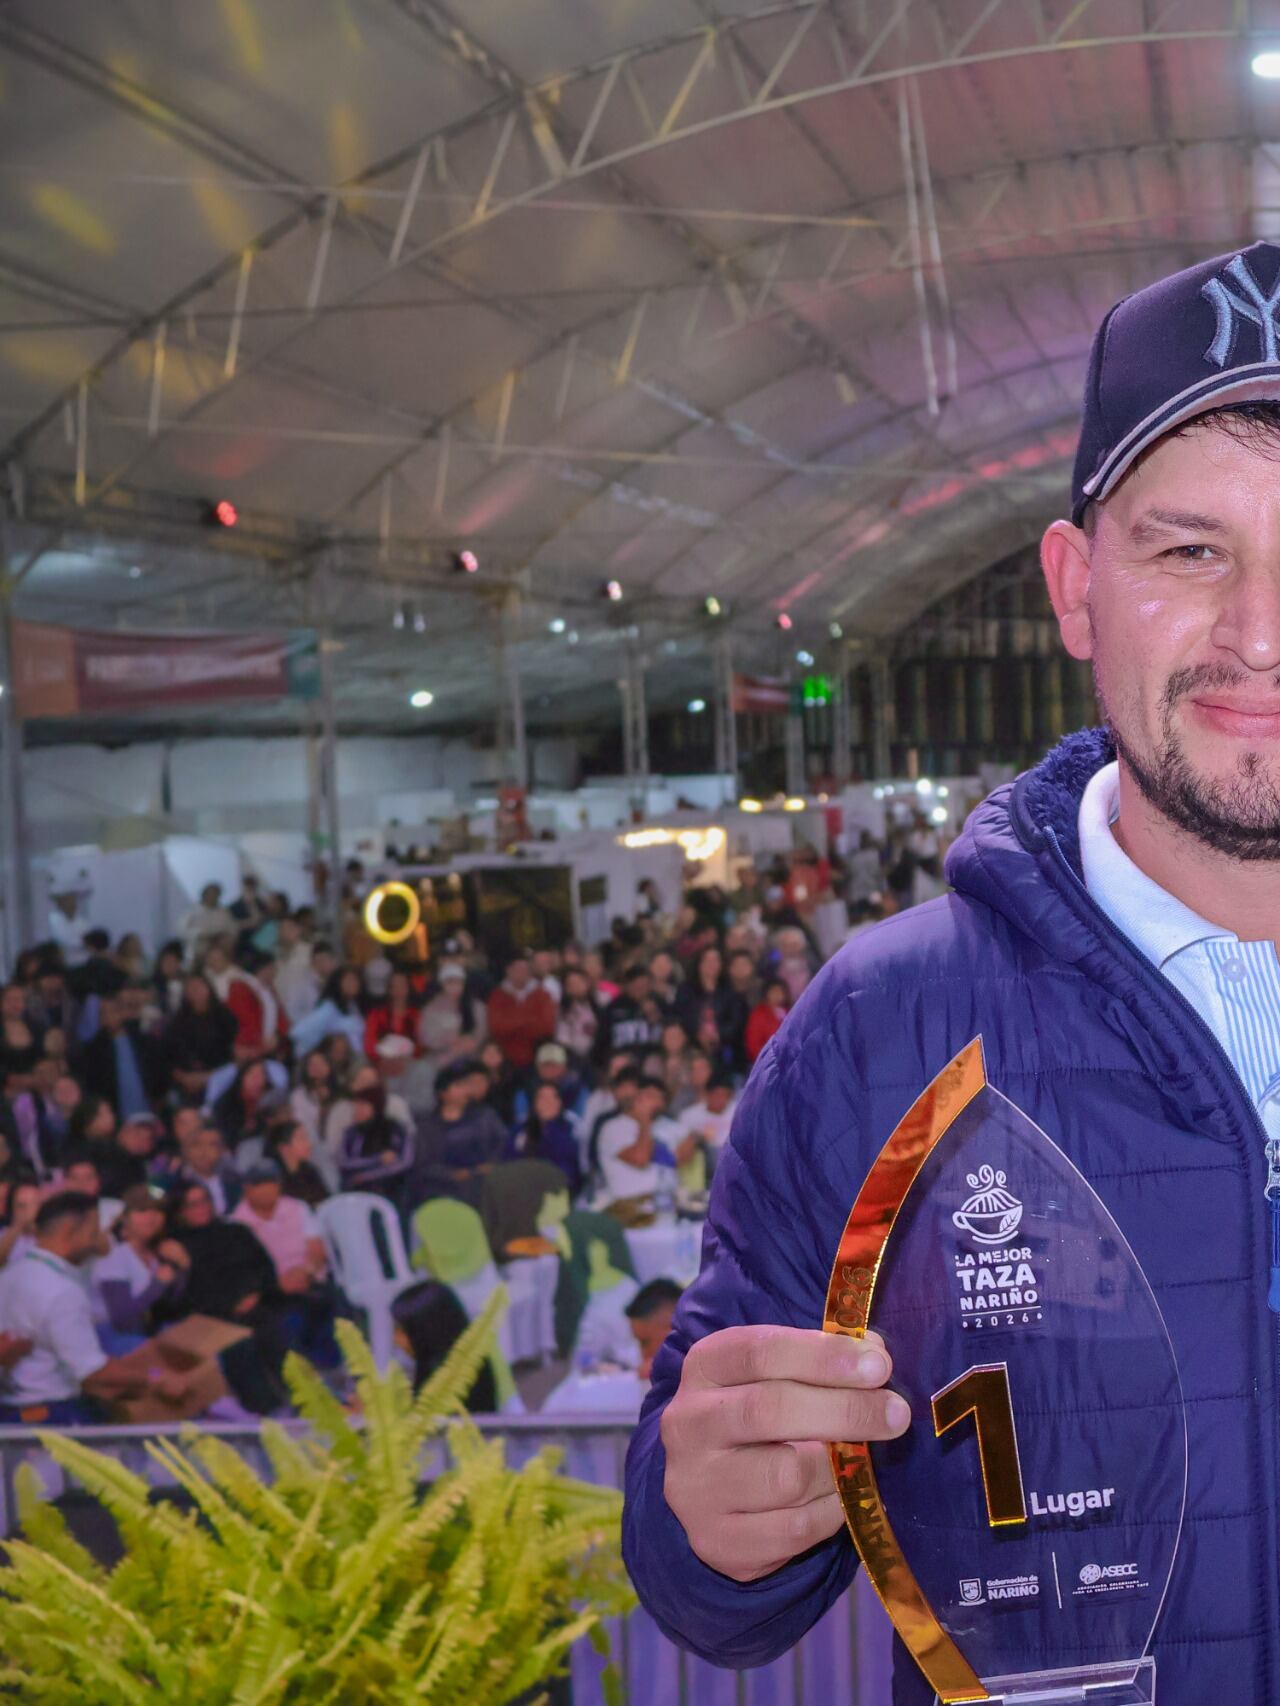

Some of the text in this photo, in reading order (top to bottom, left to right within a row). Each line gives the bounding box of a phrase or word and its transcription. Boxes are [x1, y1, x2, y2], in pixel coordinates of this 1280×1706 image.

[955, 1247, 1032, 1267] LA MEJOR
[956, 1263, 1036, 1291] TAZA
[834, 1265, 872, 1337] 026
[960, 1287, 1038, 1310] NARIÑO
[975, 1312, 1029, 1328] 2026
[931, 1361, 1115, 1527] 1 Lugar
[1029, 1574, 1038, 1582] de
[1101, 1563, 1138, 1579] ASECC
